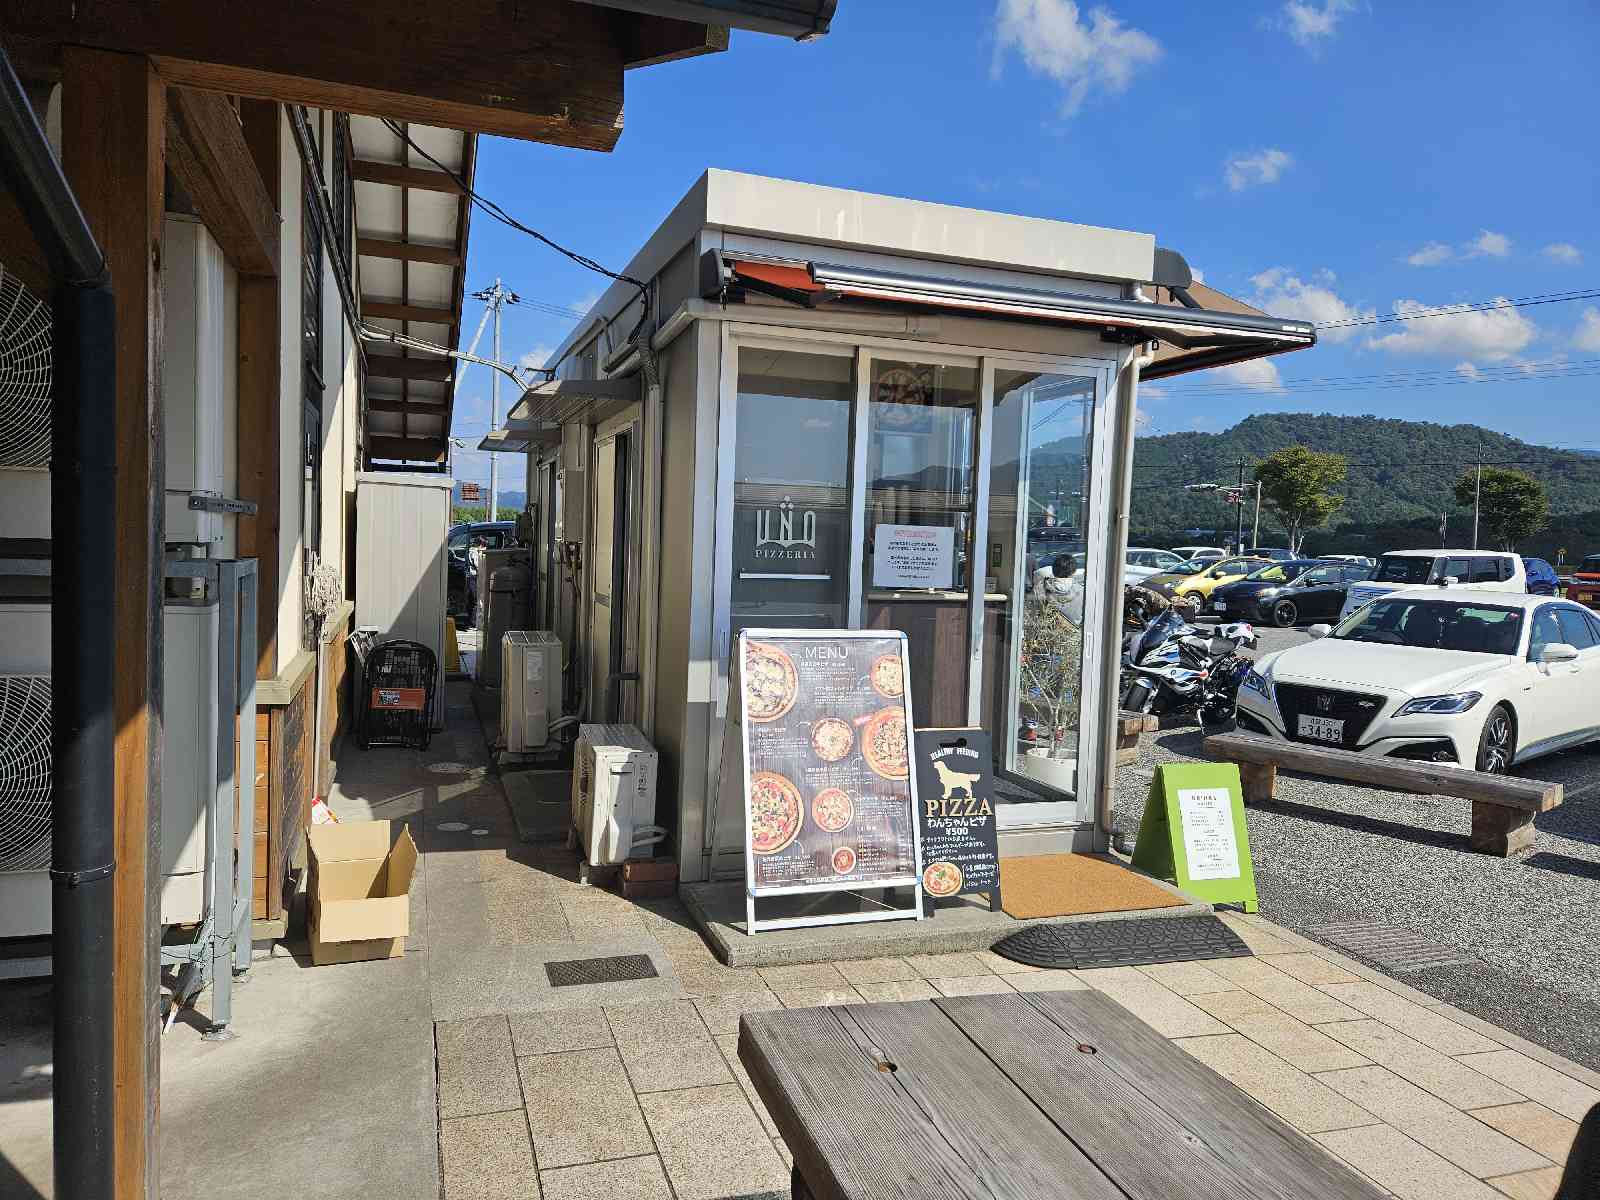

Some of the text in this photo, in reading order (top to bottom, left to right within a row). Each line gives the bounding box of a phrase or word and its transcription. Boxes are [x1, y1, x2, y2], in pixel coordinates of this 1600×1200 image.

[755, 549, 816, 559] PIZZERIA
[805, 646, 849, 659] MENU
[1308, 724, 1341, 740] 34-89
[924, 797, 993, 817] PIZZA
[927, 816, 987, 828] わんちゃんピザ
[945, 827, 969, 836] ¥500
